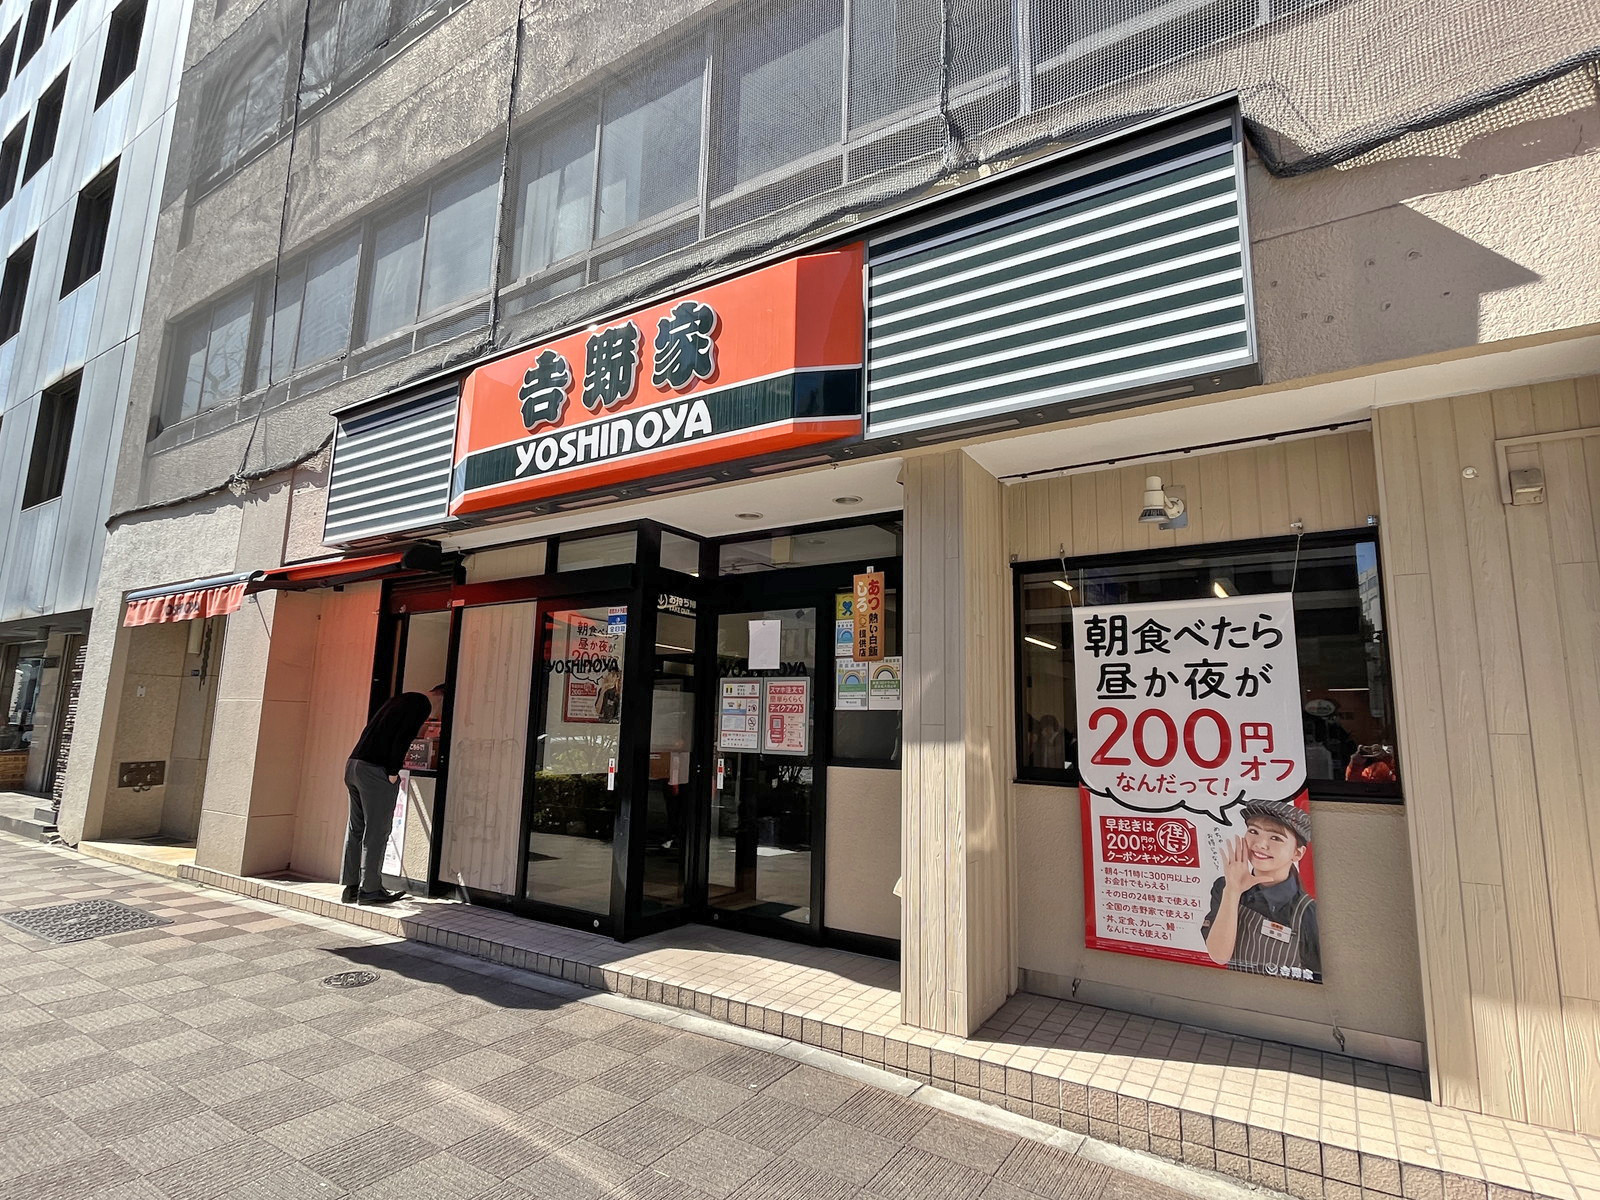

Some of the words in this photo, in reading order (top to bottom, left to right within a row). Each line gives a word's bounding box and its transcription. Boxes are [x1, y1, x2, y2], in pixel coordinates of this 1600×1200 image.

[515, 400, 712, 477] YOSHINOYA
[868, 613, 879, 657] 熱い白飯
[1084, 614, 1283, 657] 朝食べたら
[1096, 659, 1273, 700] 昼か夜が
[770, 704, 803, 712] テイクアウト
[1241, 756, 1294, 781] オフ
[1105, 818, 1155, 832] 早起きは
[1107, 851, 1195, 865] クーポンキャンペーン
